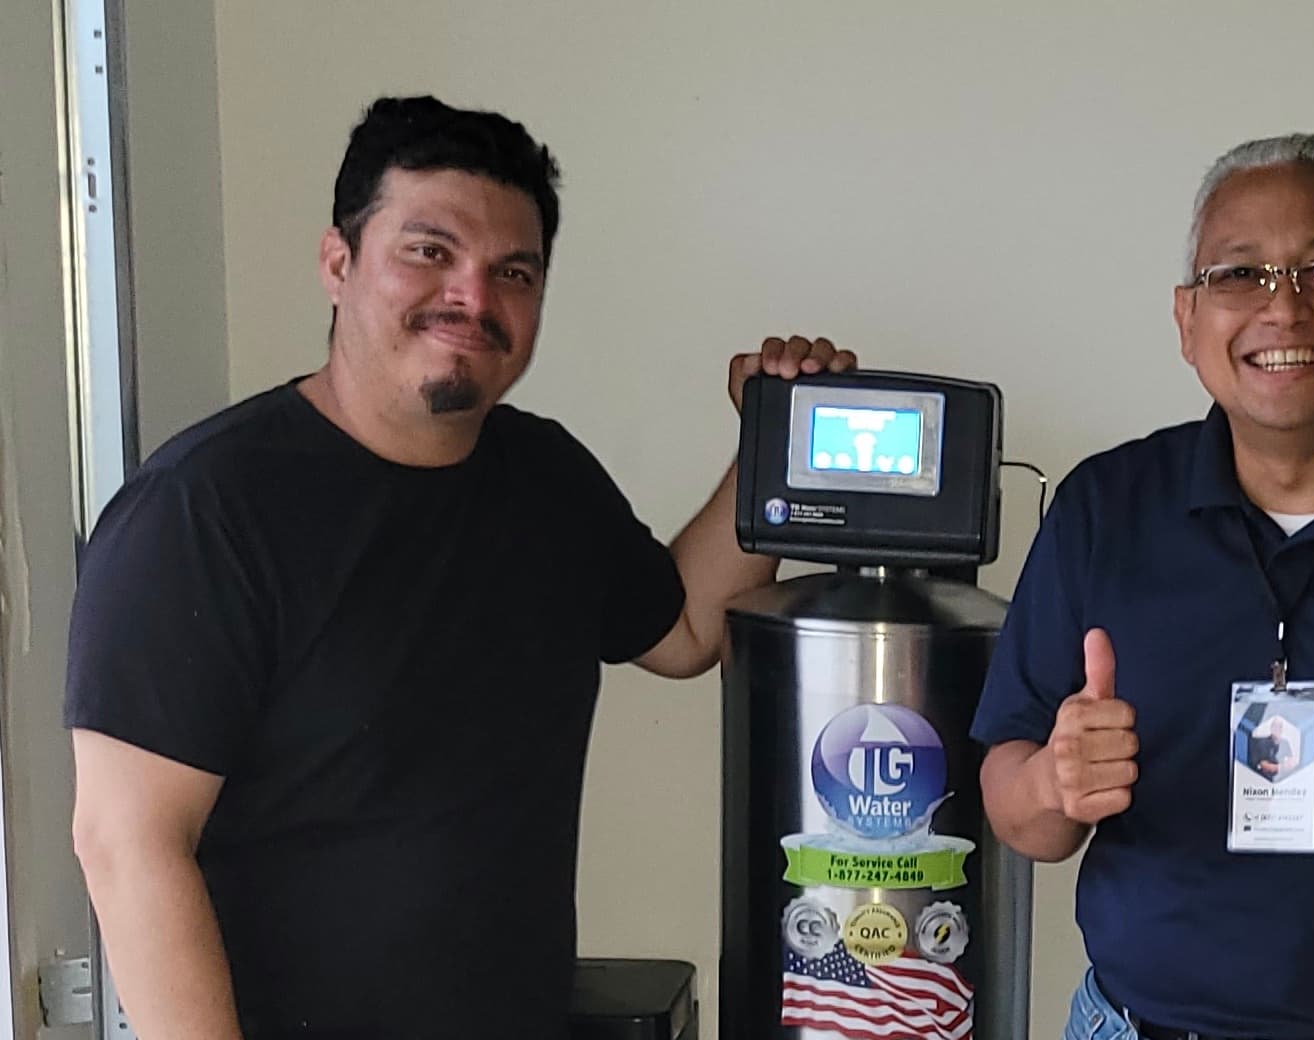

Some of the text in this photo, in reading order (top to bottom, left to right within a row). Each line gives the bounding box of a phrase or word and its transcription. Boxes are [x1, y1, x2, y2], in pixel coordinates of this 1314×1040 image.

[848, 795, 911, 816] Water
[830, 855, 917, 868] For Service Call
[796, 919, 821, 936] CC
[860, 927, 890, 939] QAC
